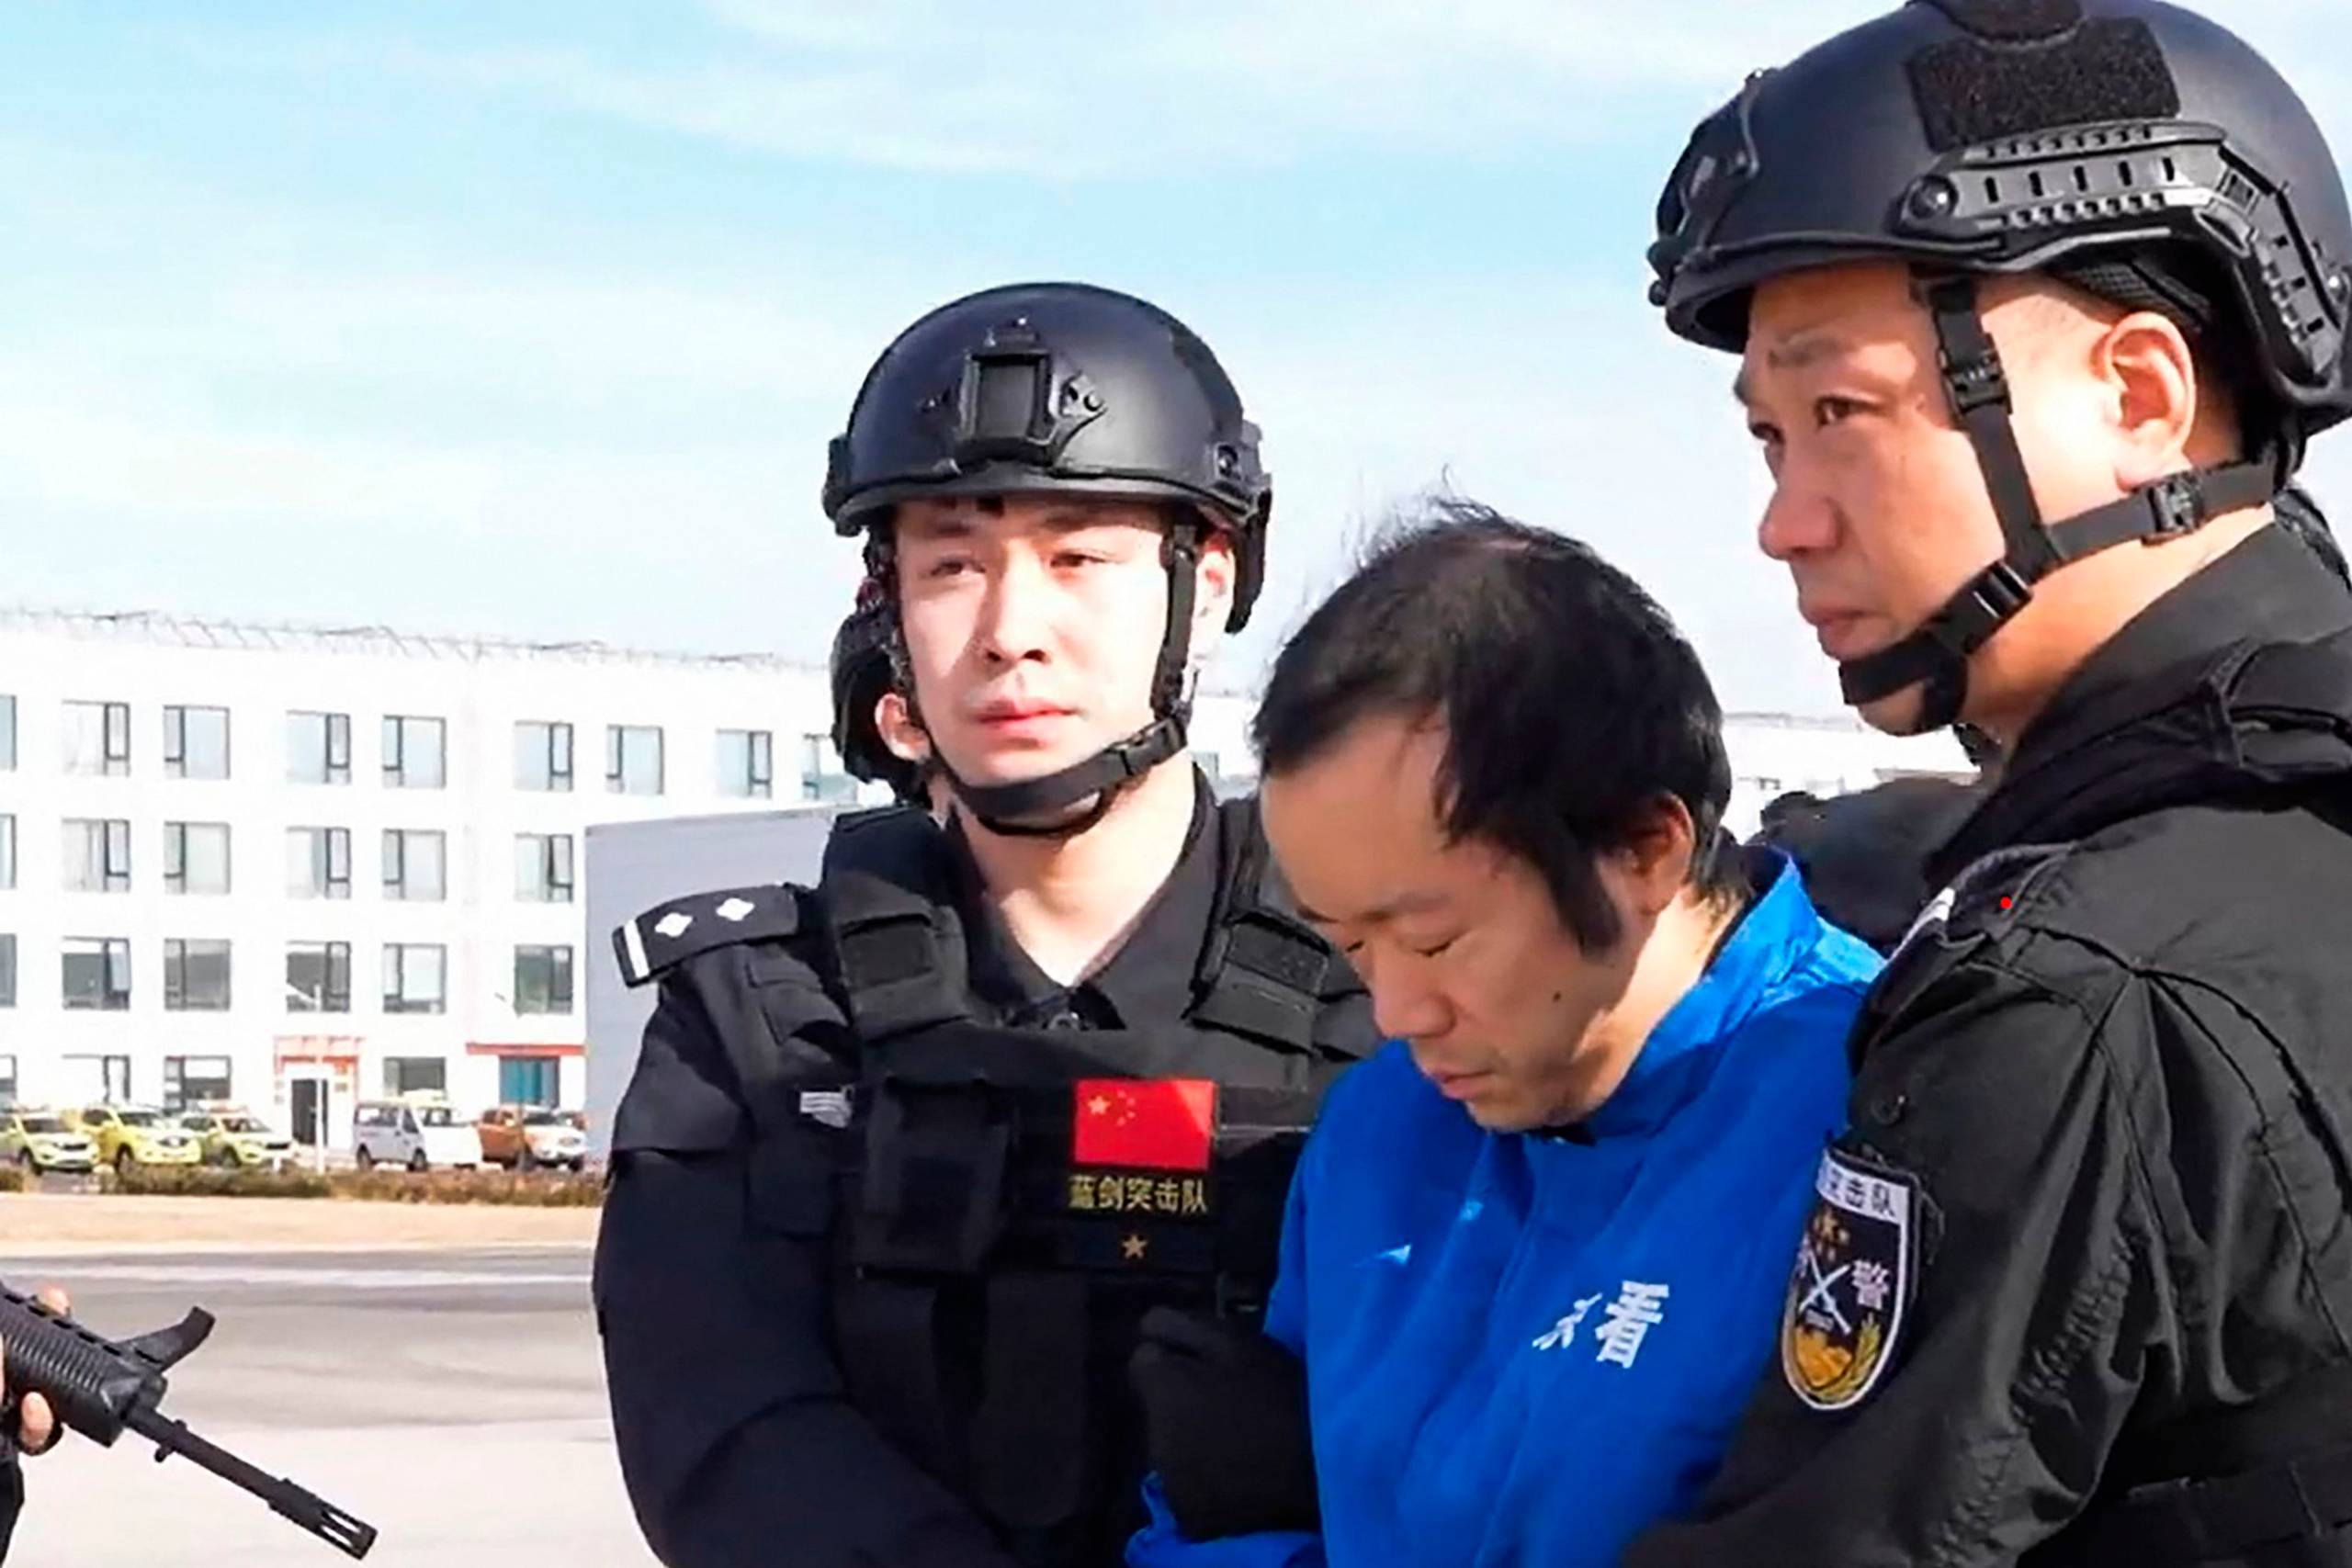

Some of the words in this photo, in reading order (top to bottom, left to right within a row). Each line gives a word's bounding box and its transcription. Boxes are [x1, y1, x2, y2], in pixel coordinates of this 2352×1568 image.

[1069, 1175, 1206, 1213] 蓝剑突击队
